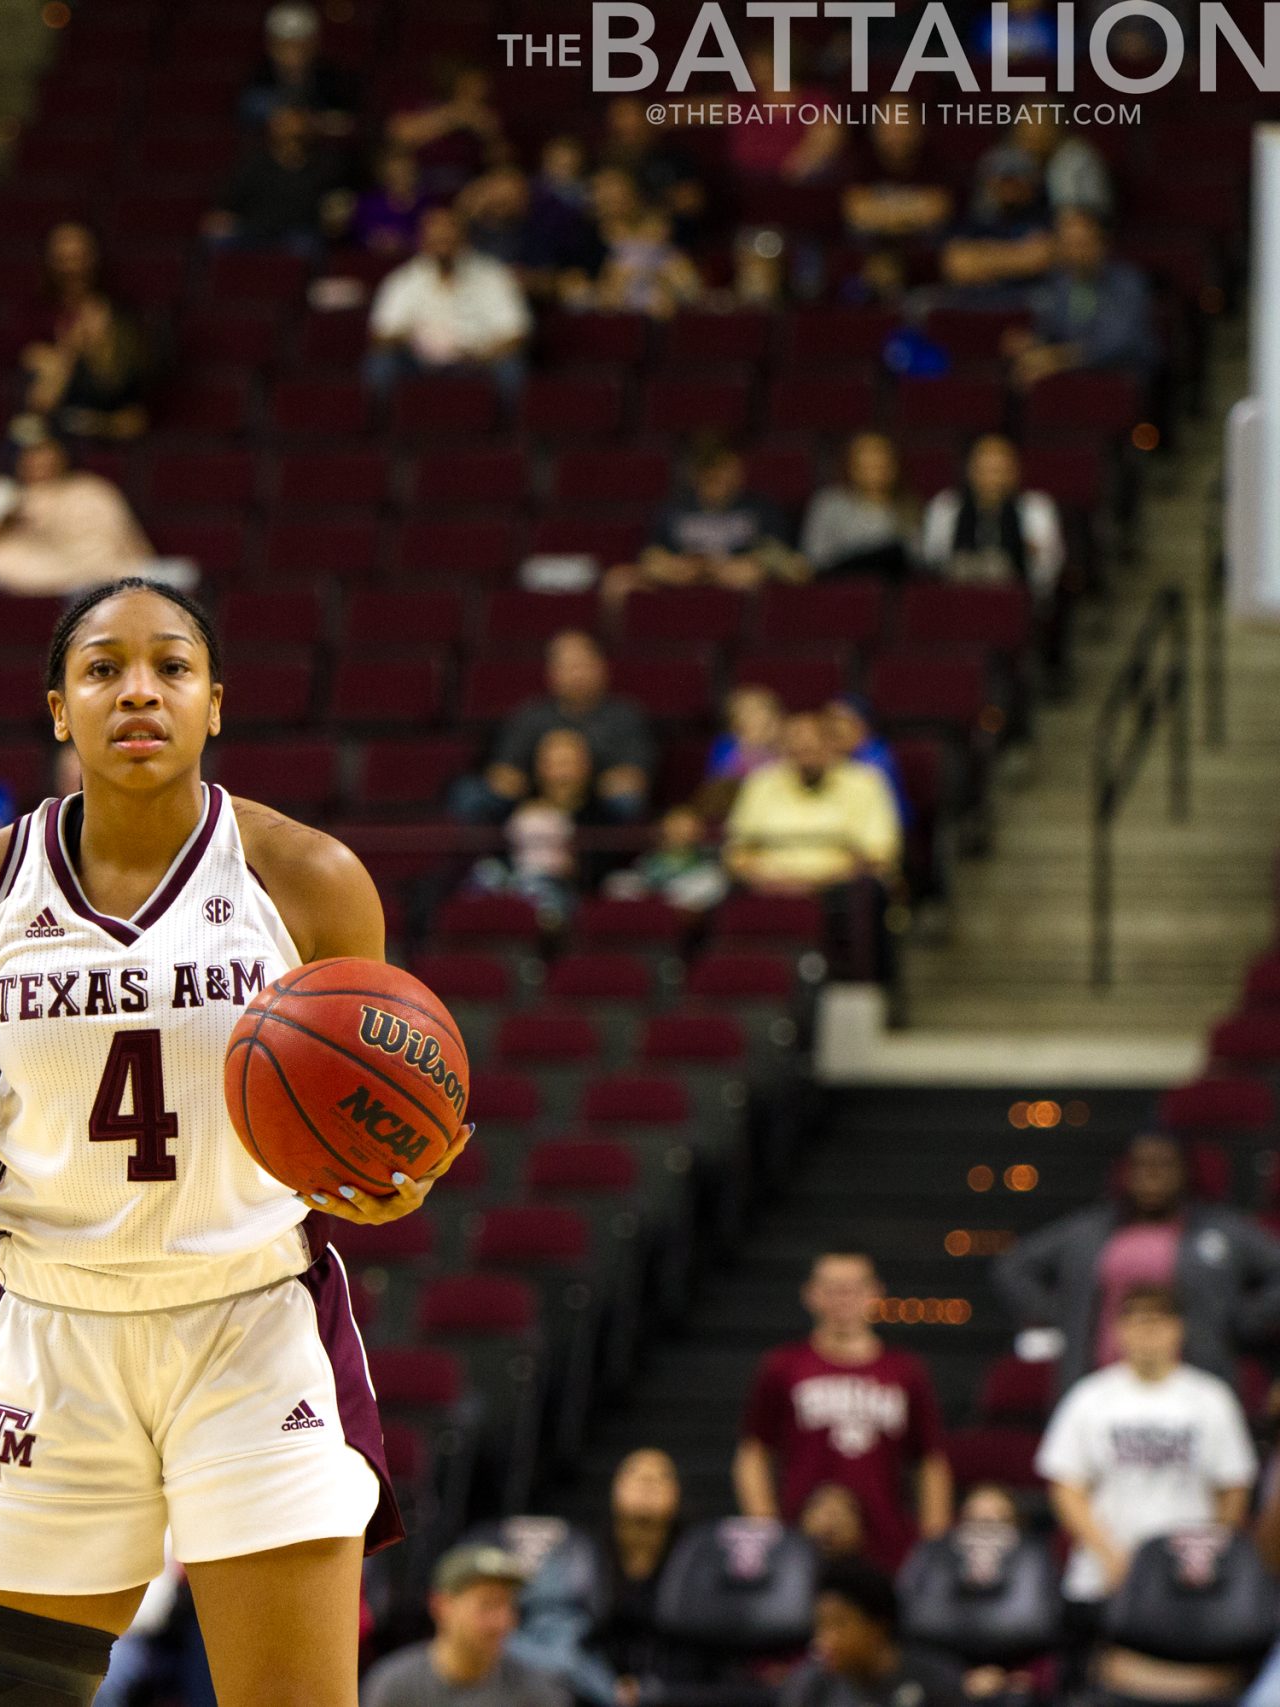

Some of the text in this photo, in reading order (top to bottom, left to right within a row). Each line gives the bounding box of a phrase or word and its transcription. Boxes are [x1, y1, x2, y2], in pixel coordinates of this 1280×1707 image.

[25, 926, 65, 938] adidas
[205, 898, 231, 924] SEC
[172, 958, 266, 1008] A&M
[359, 1004, 465, 1120] Wilson
[88, 1028, 179, 1182] 4
[336, 1084, 430, 1165] NCAA
[281, 1418, 324, 1431] adidas
